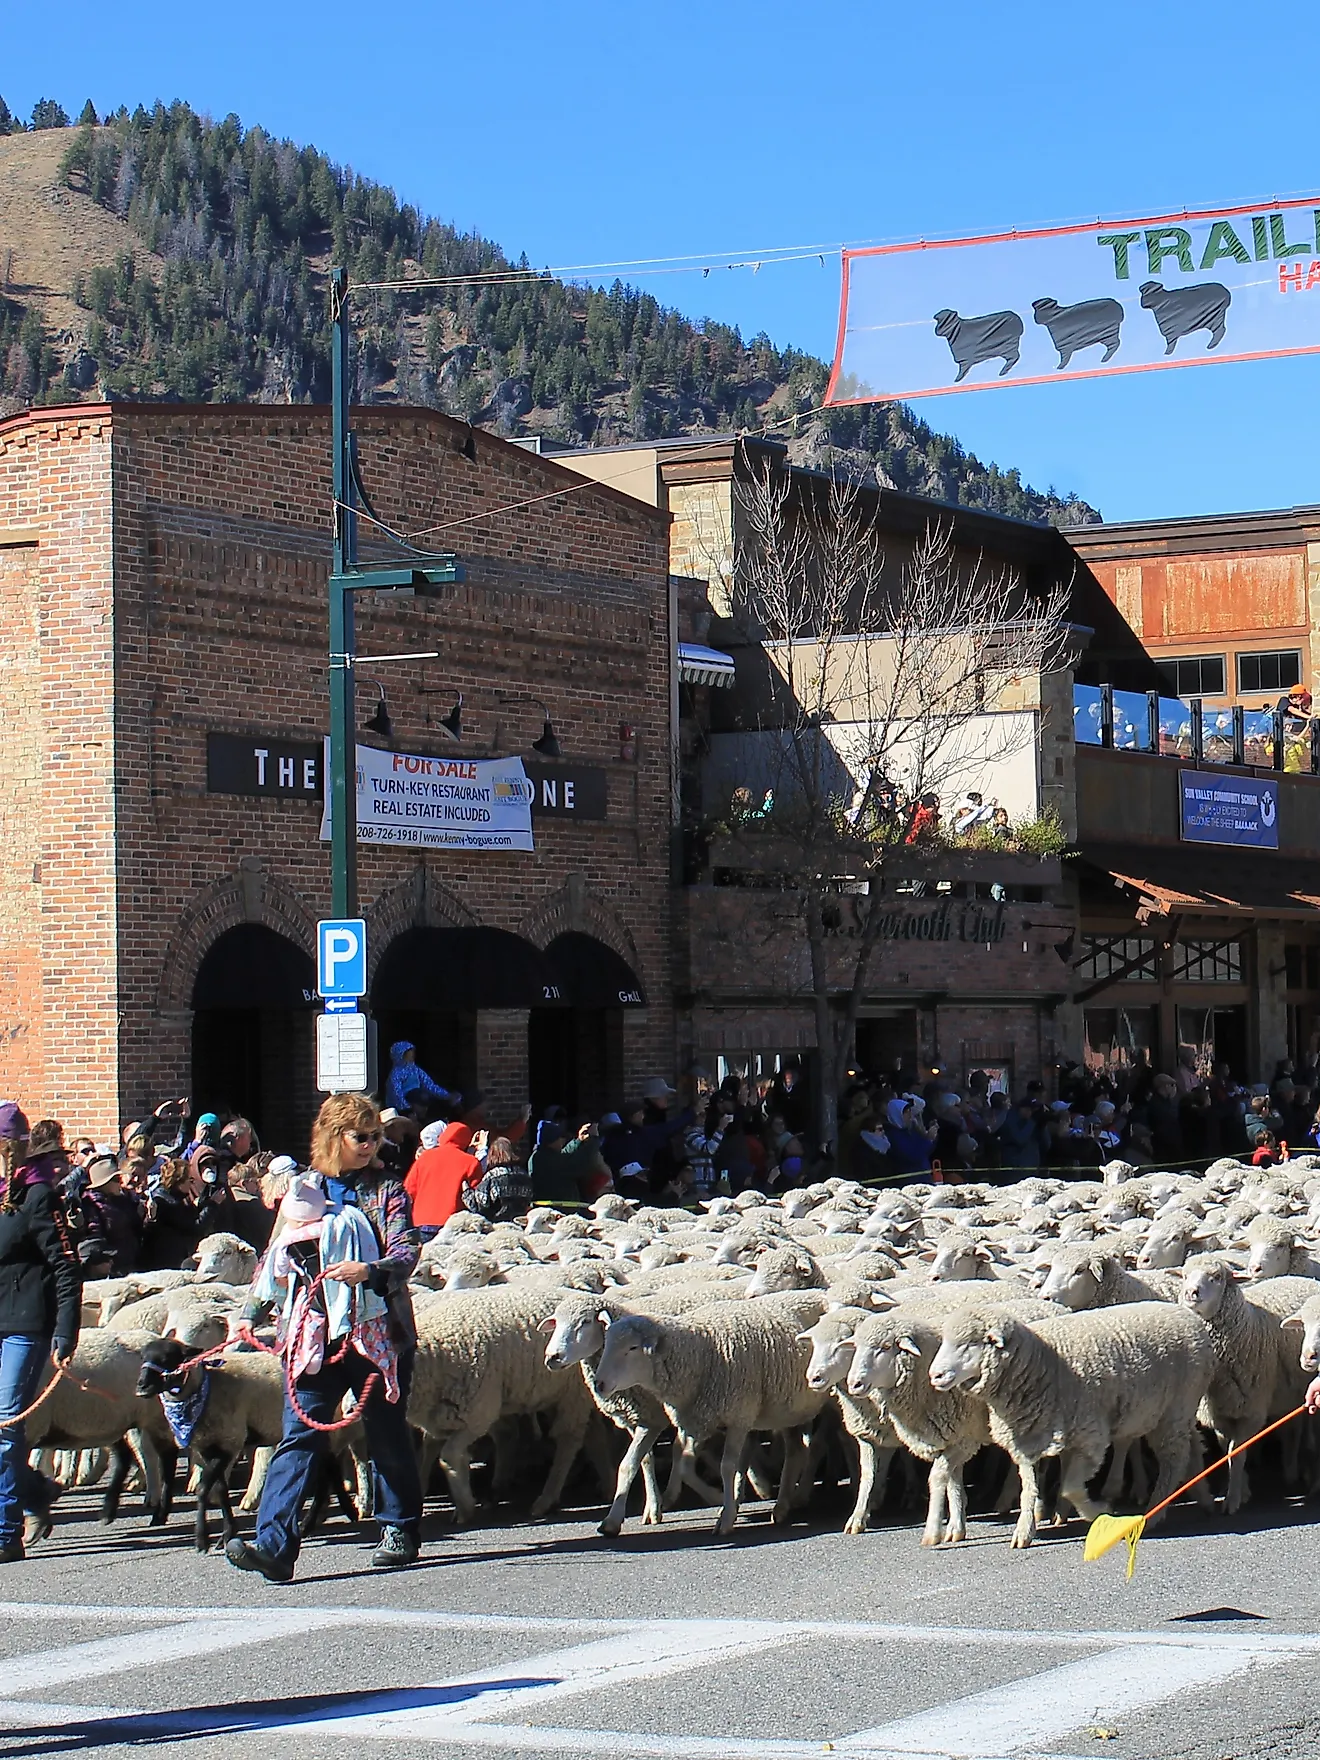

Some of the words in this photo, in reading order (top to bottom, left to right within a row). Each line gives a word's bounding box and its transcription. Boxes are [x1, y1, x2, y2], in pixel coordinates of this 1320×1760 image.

[254, 749, 315, 789] THE
[392, 754, 432, 775] FOR
[436, 761, 477, 780] SALE
[371, 778, 430, 796] TURN-KEY
[432, 783, 490, 802] RESTAURANT
[1195, 788, 1213, 801] VALLEY
[1241, 793, 1258, 806] SCHOOL
[373, 801, 403, 816] REAL
[406, 802, 442, 819] ESTATE
[444, 805, 491, 822] INCLUDED
[356, 826, 418, 841] 208-726-1918
[423, 832, 512, 847] www.kenny-bogue.com
[325, 929, 358, 987] P
[302, 988, 323, 1001] BA
